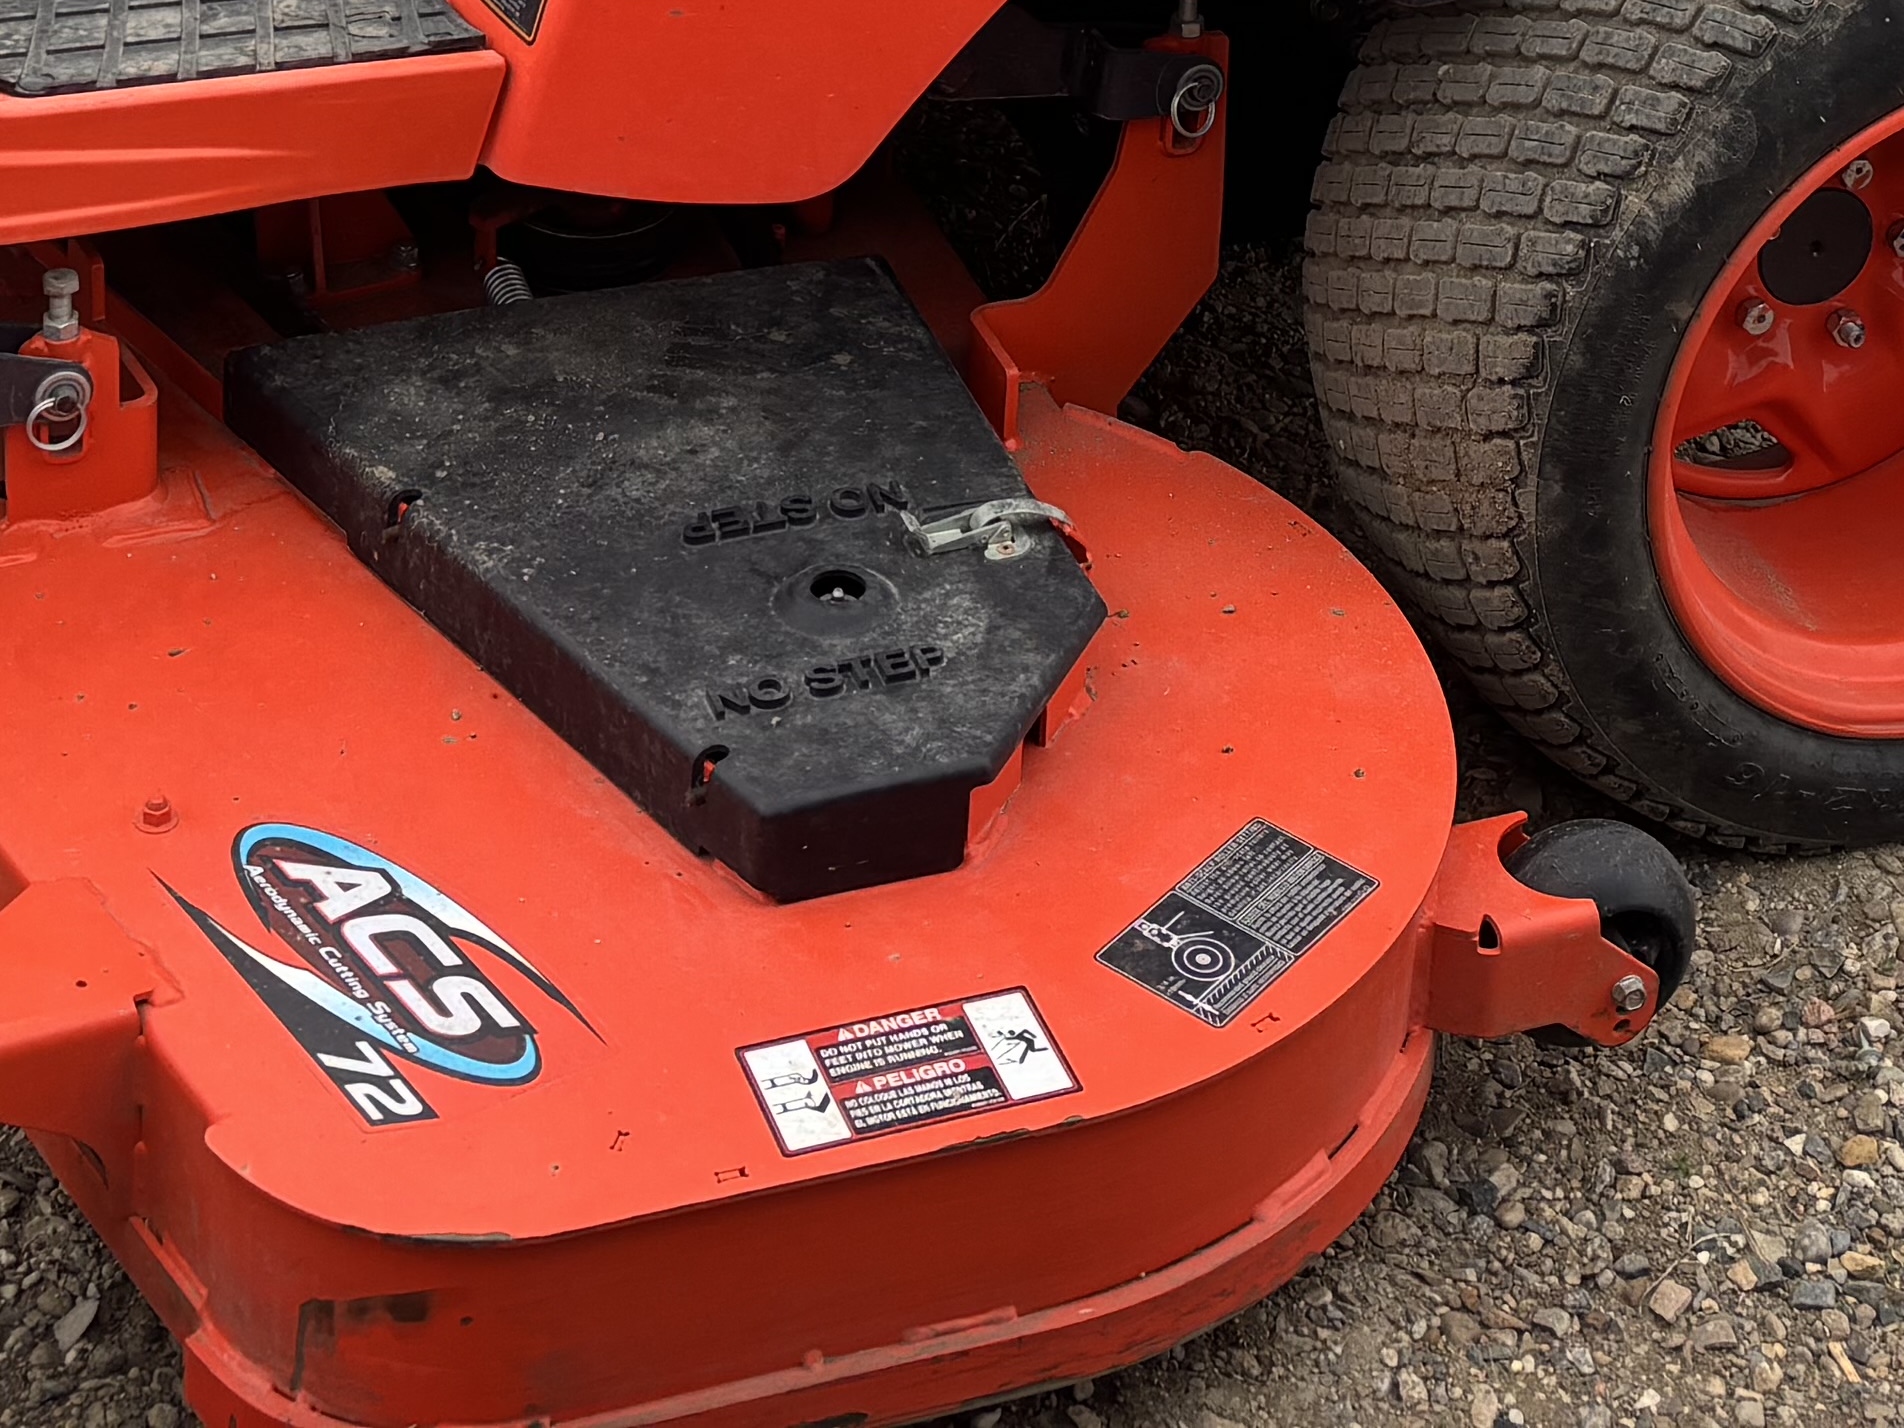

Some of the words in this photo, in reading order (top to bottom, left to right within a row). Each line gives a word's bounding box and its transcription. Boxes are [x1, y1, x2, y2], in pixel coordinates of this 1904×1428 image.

[827, 480, 909, 520] NO
[682, 495, 819, 546] STEP
[705, 675, 793, 721] NO
[803, 645, 947, 700] STEP
[245, 863, 322, 948] Aerodynamic
[318, 945, 370, 1001] Cutting
[366, 1000, 420, 1055] System
[274, 858, 521, 1037] ACS
[819, 1047, 838, 1059] DO
[839, 1041, 863, 1056] NOT
[866, 1035, 887, 1050] PUT
[889, 1029, 928, 1046] HANDS
[931, 1023, 948, 1036] OR
[853, 1007, 942, 1039] DANGER
[824, 1055, 852, 1069] FEET
[855, 1049, 884, 1063] INTO
[885, 1038, 929, 1057] MOWER
[929, 1030, 965, 1046] WHEN
[829, 1062, 872, 1078] ENGINE
[874, 1057, 885, 1068] IS
[887, 1047, 943, 1067] RUNNING.
[317, 1040, 424, 1121] 72
[844, 1099, 858, 1109] NO
[858, 1091, 897, 1107] COLOQUE
[898, 1086, 914, 1098] LAS
[914, 1079, 943, 1094] MANOS
[954, 1073, 971, 1085] LOS
[873, 1058, 966, 1091] PELIGRO
[849, 1107, 869, 1118] PIES
[882, 1101, 894, 1112] LA
[894, 1090, 942, 1109] CORTADORA
[943, 1081, 985, 1098] MIENTRAS
[854, 1119, 867, 1129] EL
[867, 1110, 897, 1125] MOTOR
[919, 1103, 931, 1114] EN
